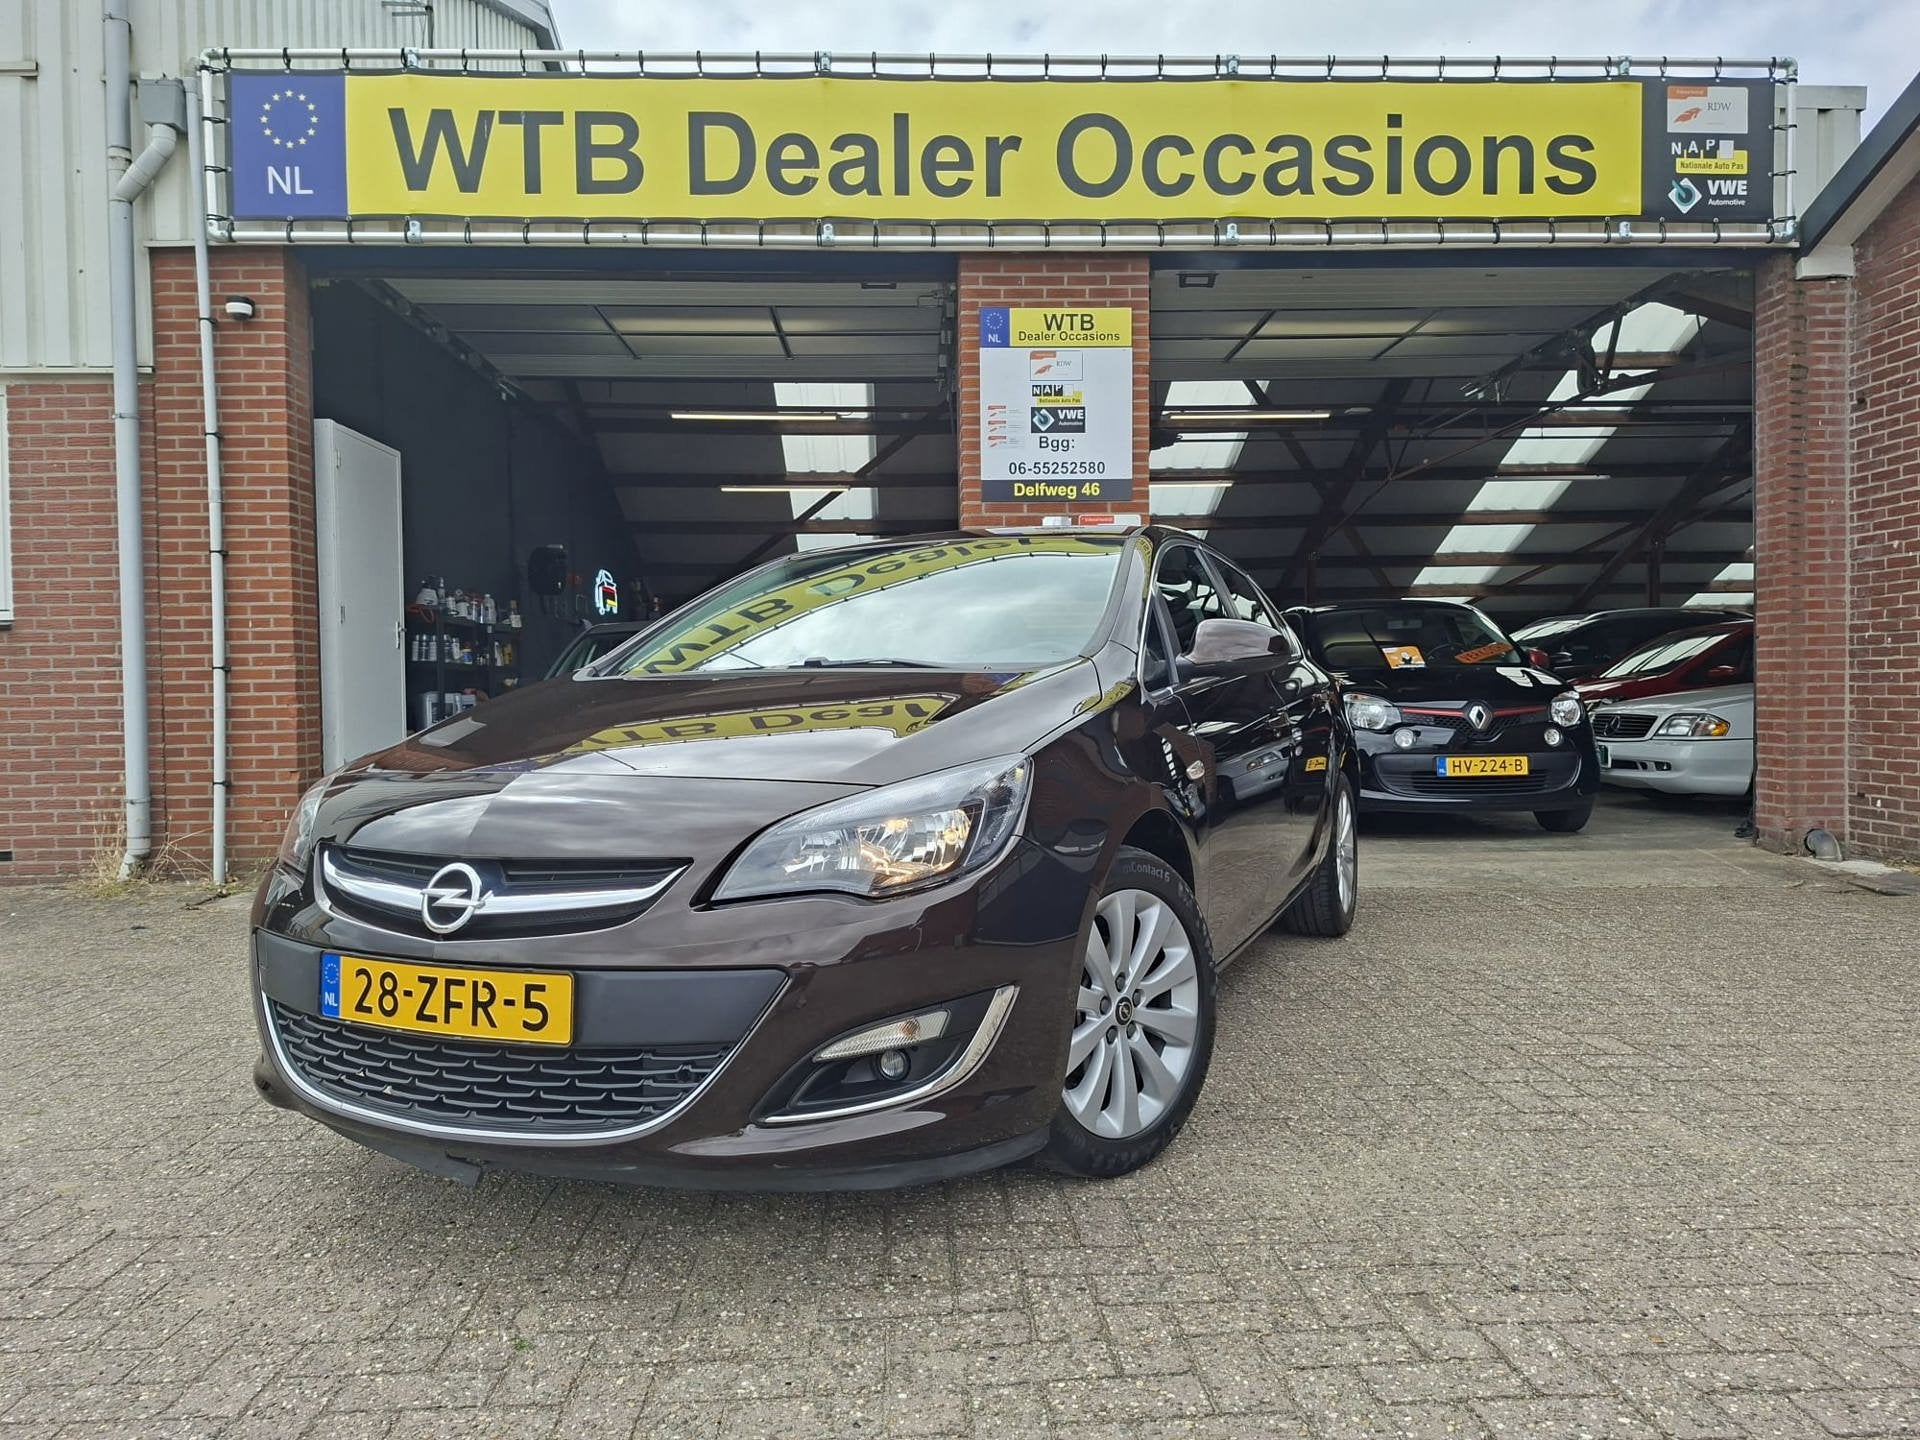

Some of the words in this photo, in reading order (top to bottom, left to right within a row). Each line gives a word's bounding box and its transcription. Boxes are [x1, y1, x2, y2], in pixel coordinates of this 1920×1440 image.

[1707, 102, 1732, 111] RDW
[388, 108, 644, 196] WTB
[688, 111, 1021, 197] Dealer
[1056, 112, 1598, 199] Occasions
[1680, 160, 1713, 170] Nationale
[1714, 160, 1730, 170] Auto
[1731, 161, 1744, 170] Pas
[266, 166, 314, 196] NL
[1707, 180, 1748, 195] VWE
[1043, 313, 1094, 331] WTB
[988, 334, 1001, 343] NL
[1018, 331, 1056, 341] Dealer
[1059, 331, 1121, 341] Occasions
[1057, 410, 1084, 419] VWE
[1039, 436, 1075, 451] Bgg:
[1008, 461, 1105, 475] 06-55252580
[1013, 482, 1077, 498] Delfweg
[1081, 482, 1100, 496] 46
[1452, 759, 1523, 773] HV-224-B
[324, 991, 338, 1007] NL
[354, 967, 549, 1032] 28-ZFR-5
